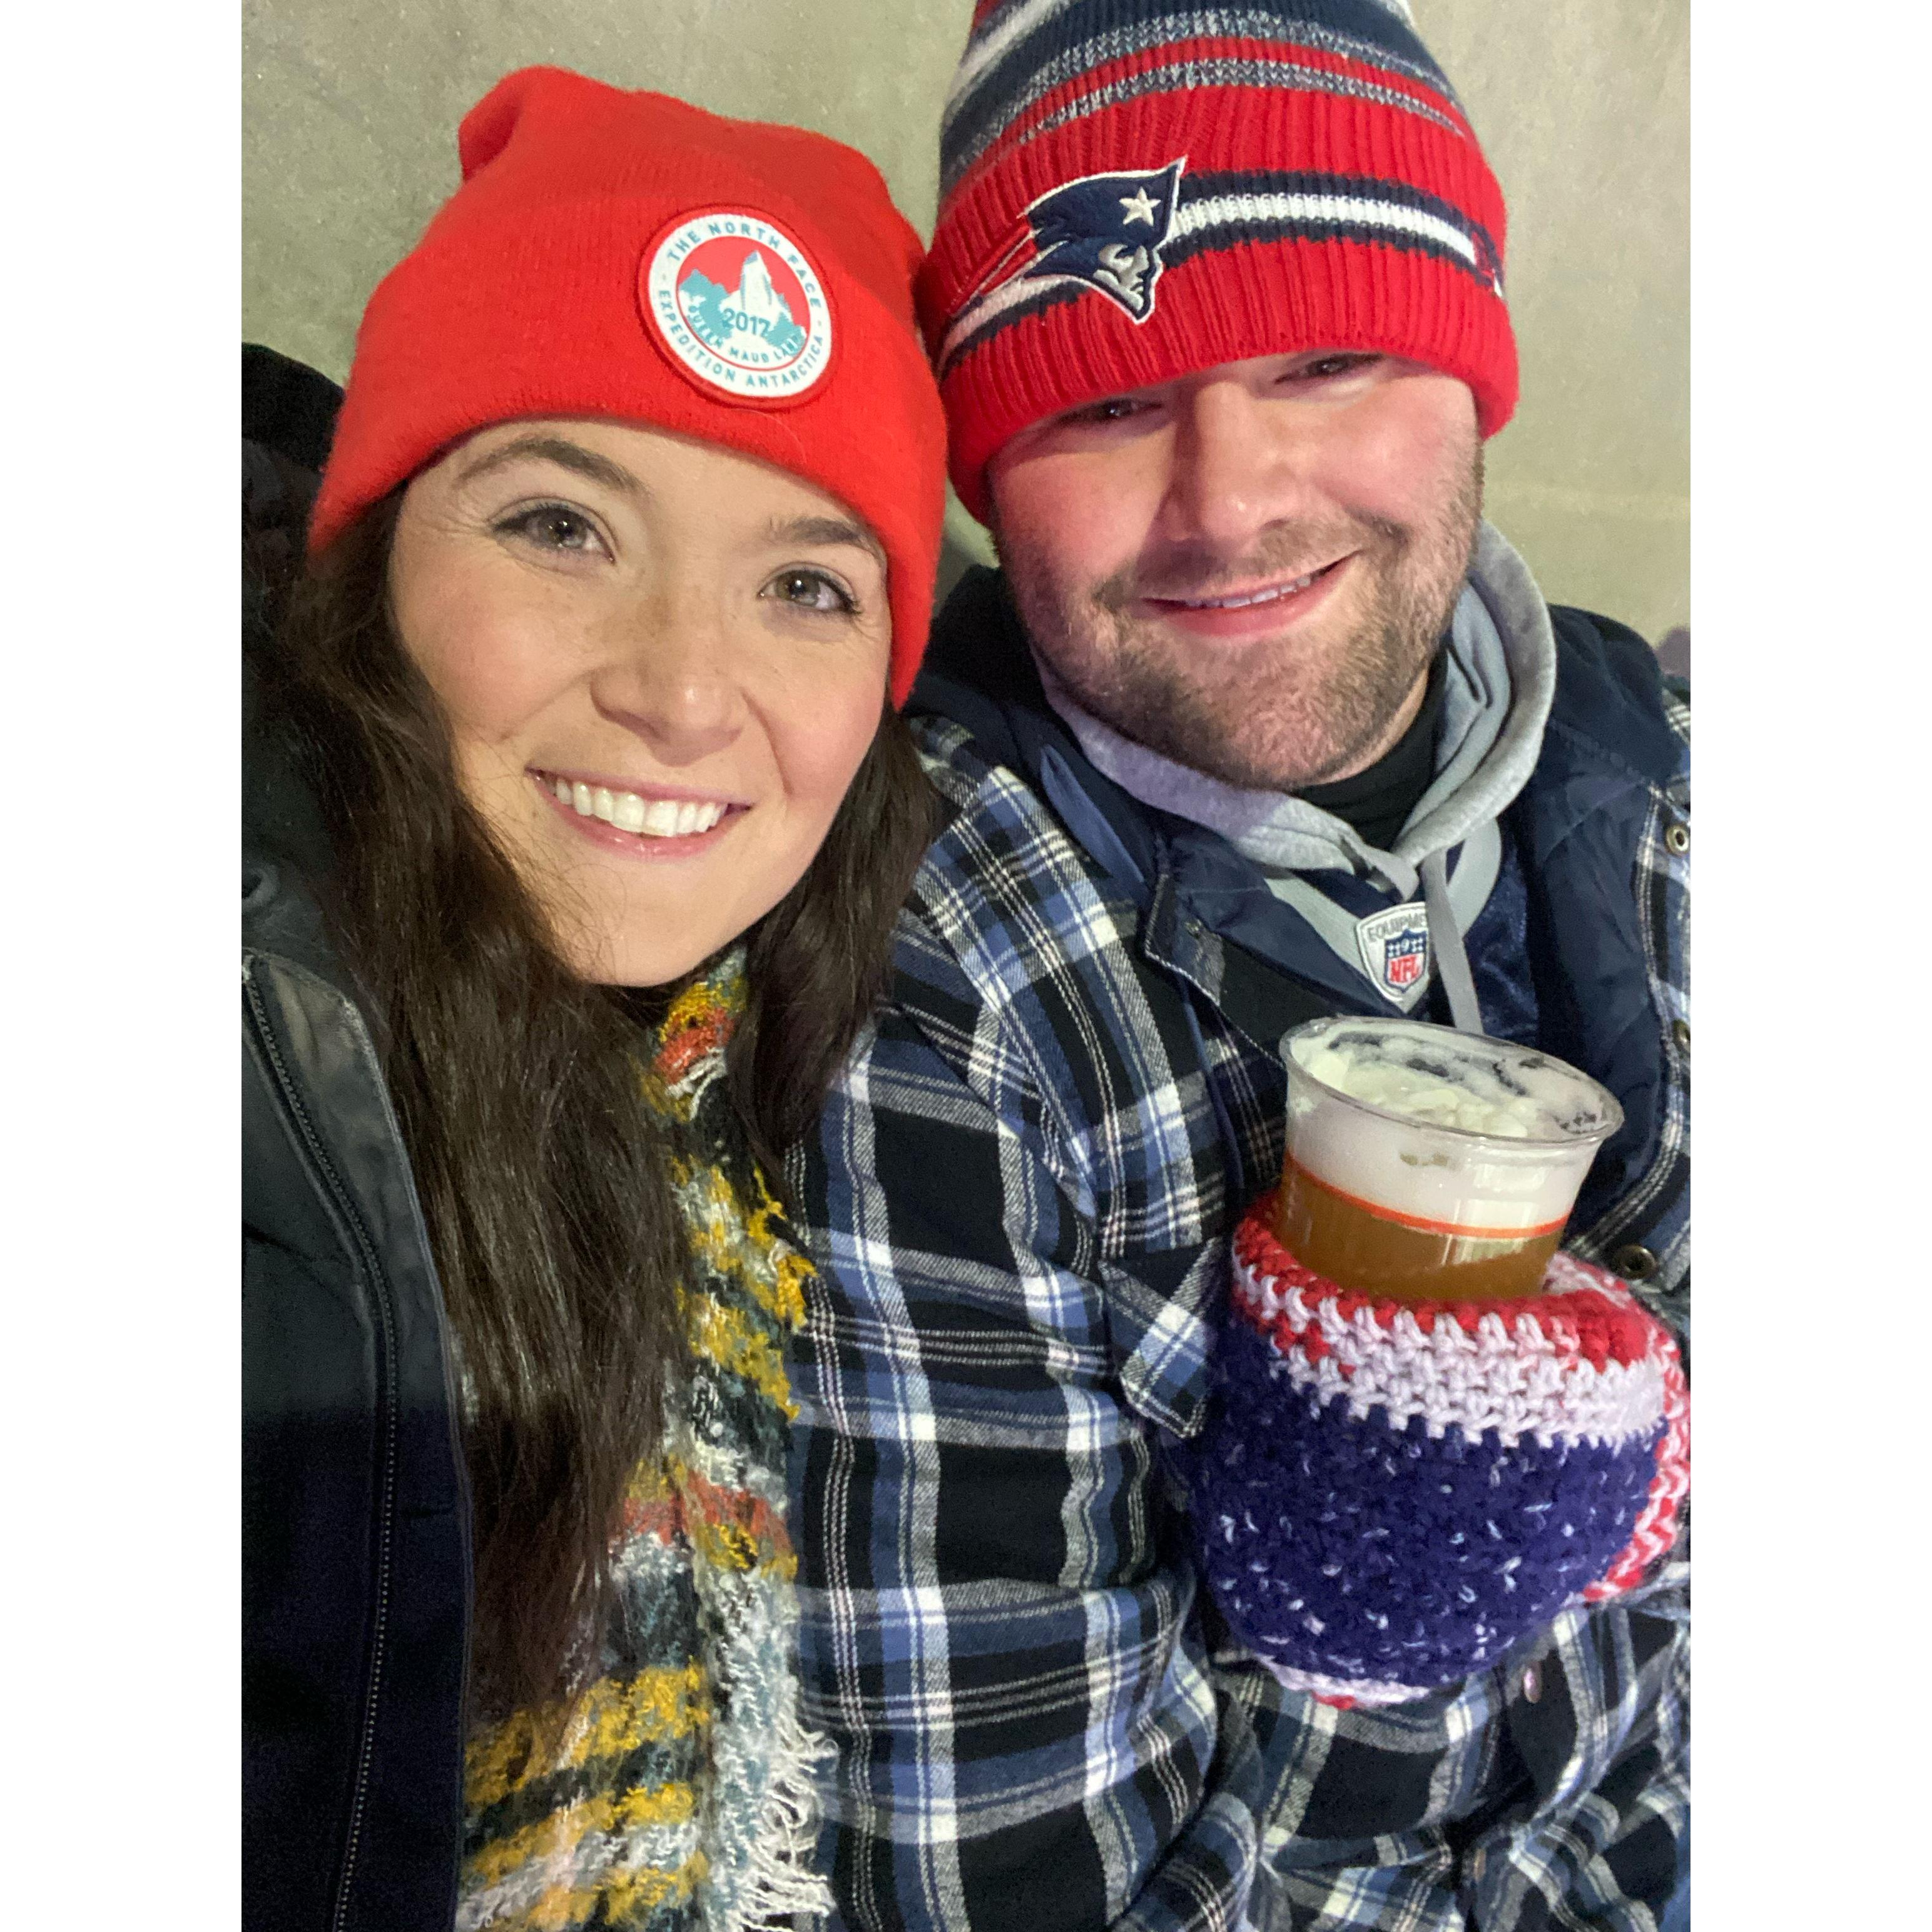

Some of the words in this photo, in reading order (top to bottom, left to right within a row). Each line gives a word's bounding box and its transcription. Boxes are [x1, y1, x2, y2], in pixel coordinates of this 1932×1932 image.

[667, 230, 701, 262] THE
[708, 221, 780, 250] NORTH
[787, 254, 821, 308] FACE
[722, 308, 771, 338] 2017
[659, 290, 736, 382] EXPEDITION
[745, 335, 823, 388] ANTARCTICA
[729, 346, 770, 364] MAUD
[1390, 955, 1421, 983] NFL
